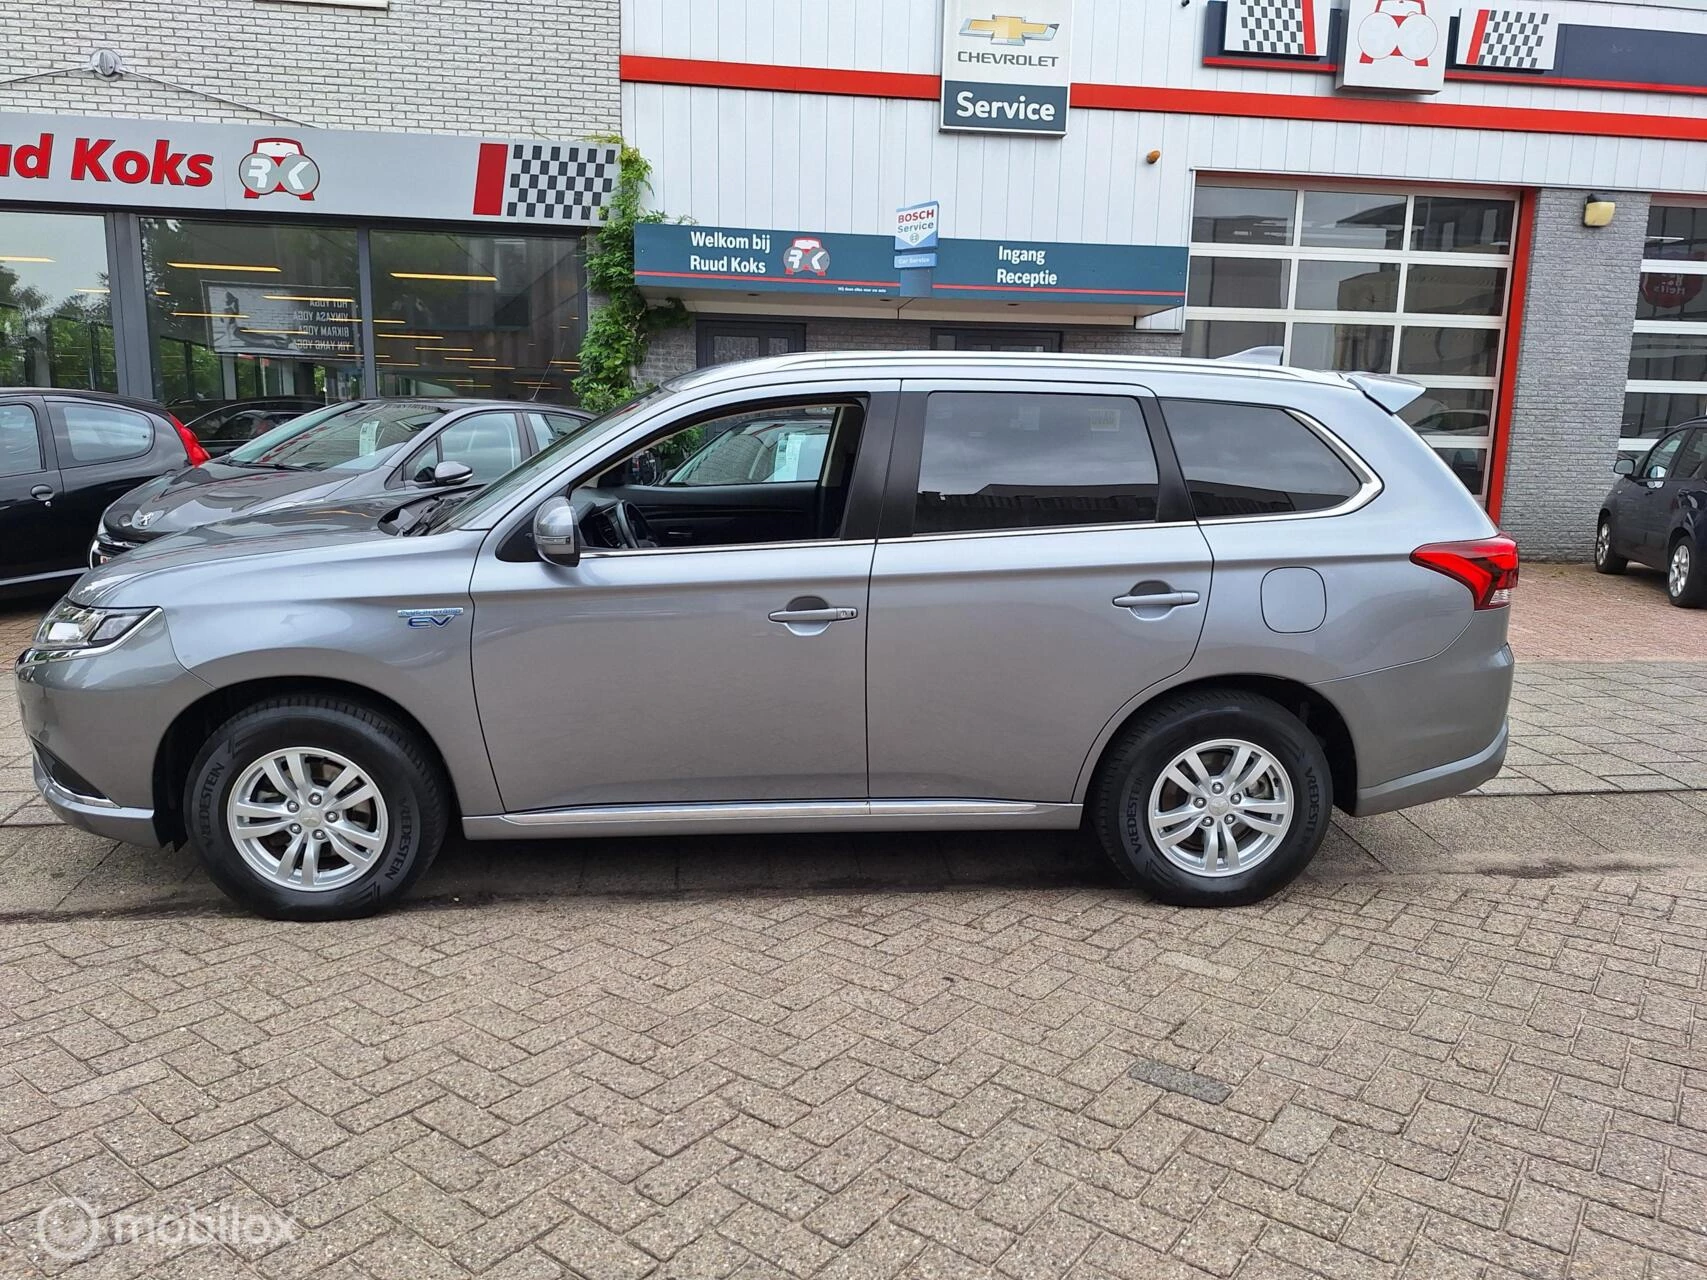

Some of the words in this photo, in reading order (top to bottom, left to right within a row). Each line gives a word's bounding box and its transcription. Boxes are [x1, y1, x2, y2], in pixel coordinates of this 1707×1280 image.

[957, 51, 1059, 67] CHEVROLET
[956, 91, 1055, 121] Service
[71, 137, 214, 187] Koks
[898, 209, 934, 223] BOSCH
[898, 222, 934, 233] Service
[690, 231, 749, 249] Welkom
[752, 234, 771, 253] bij
[690, 255, 728, 272] Ruud
[731, 257, 766, 273] Koks
[998, 245, 1046, 265] Ingang
[997, 268, 1057, 287] Receptie
[408, 614, 454, 629] EV
[199, 762, 225, 848] VREDESTEIN
[385, 797, 412, 880] VREDESTEIN
